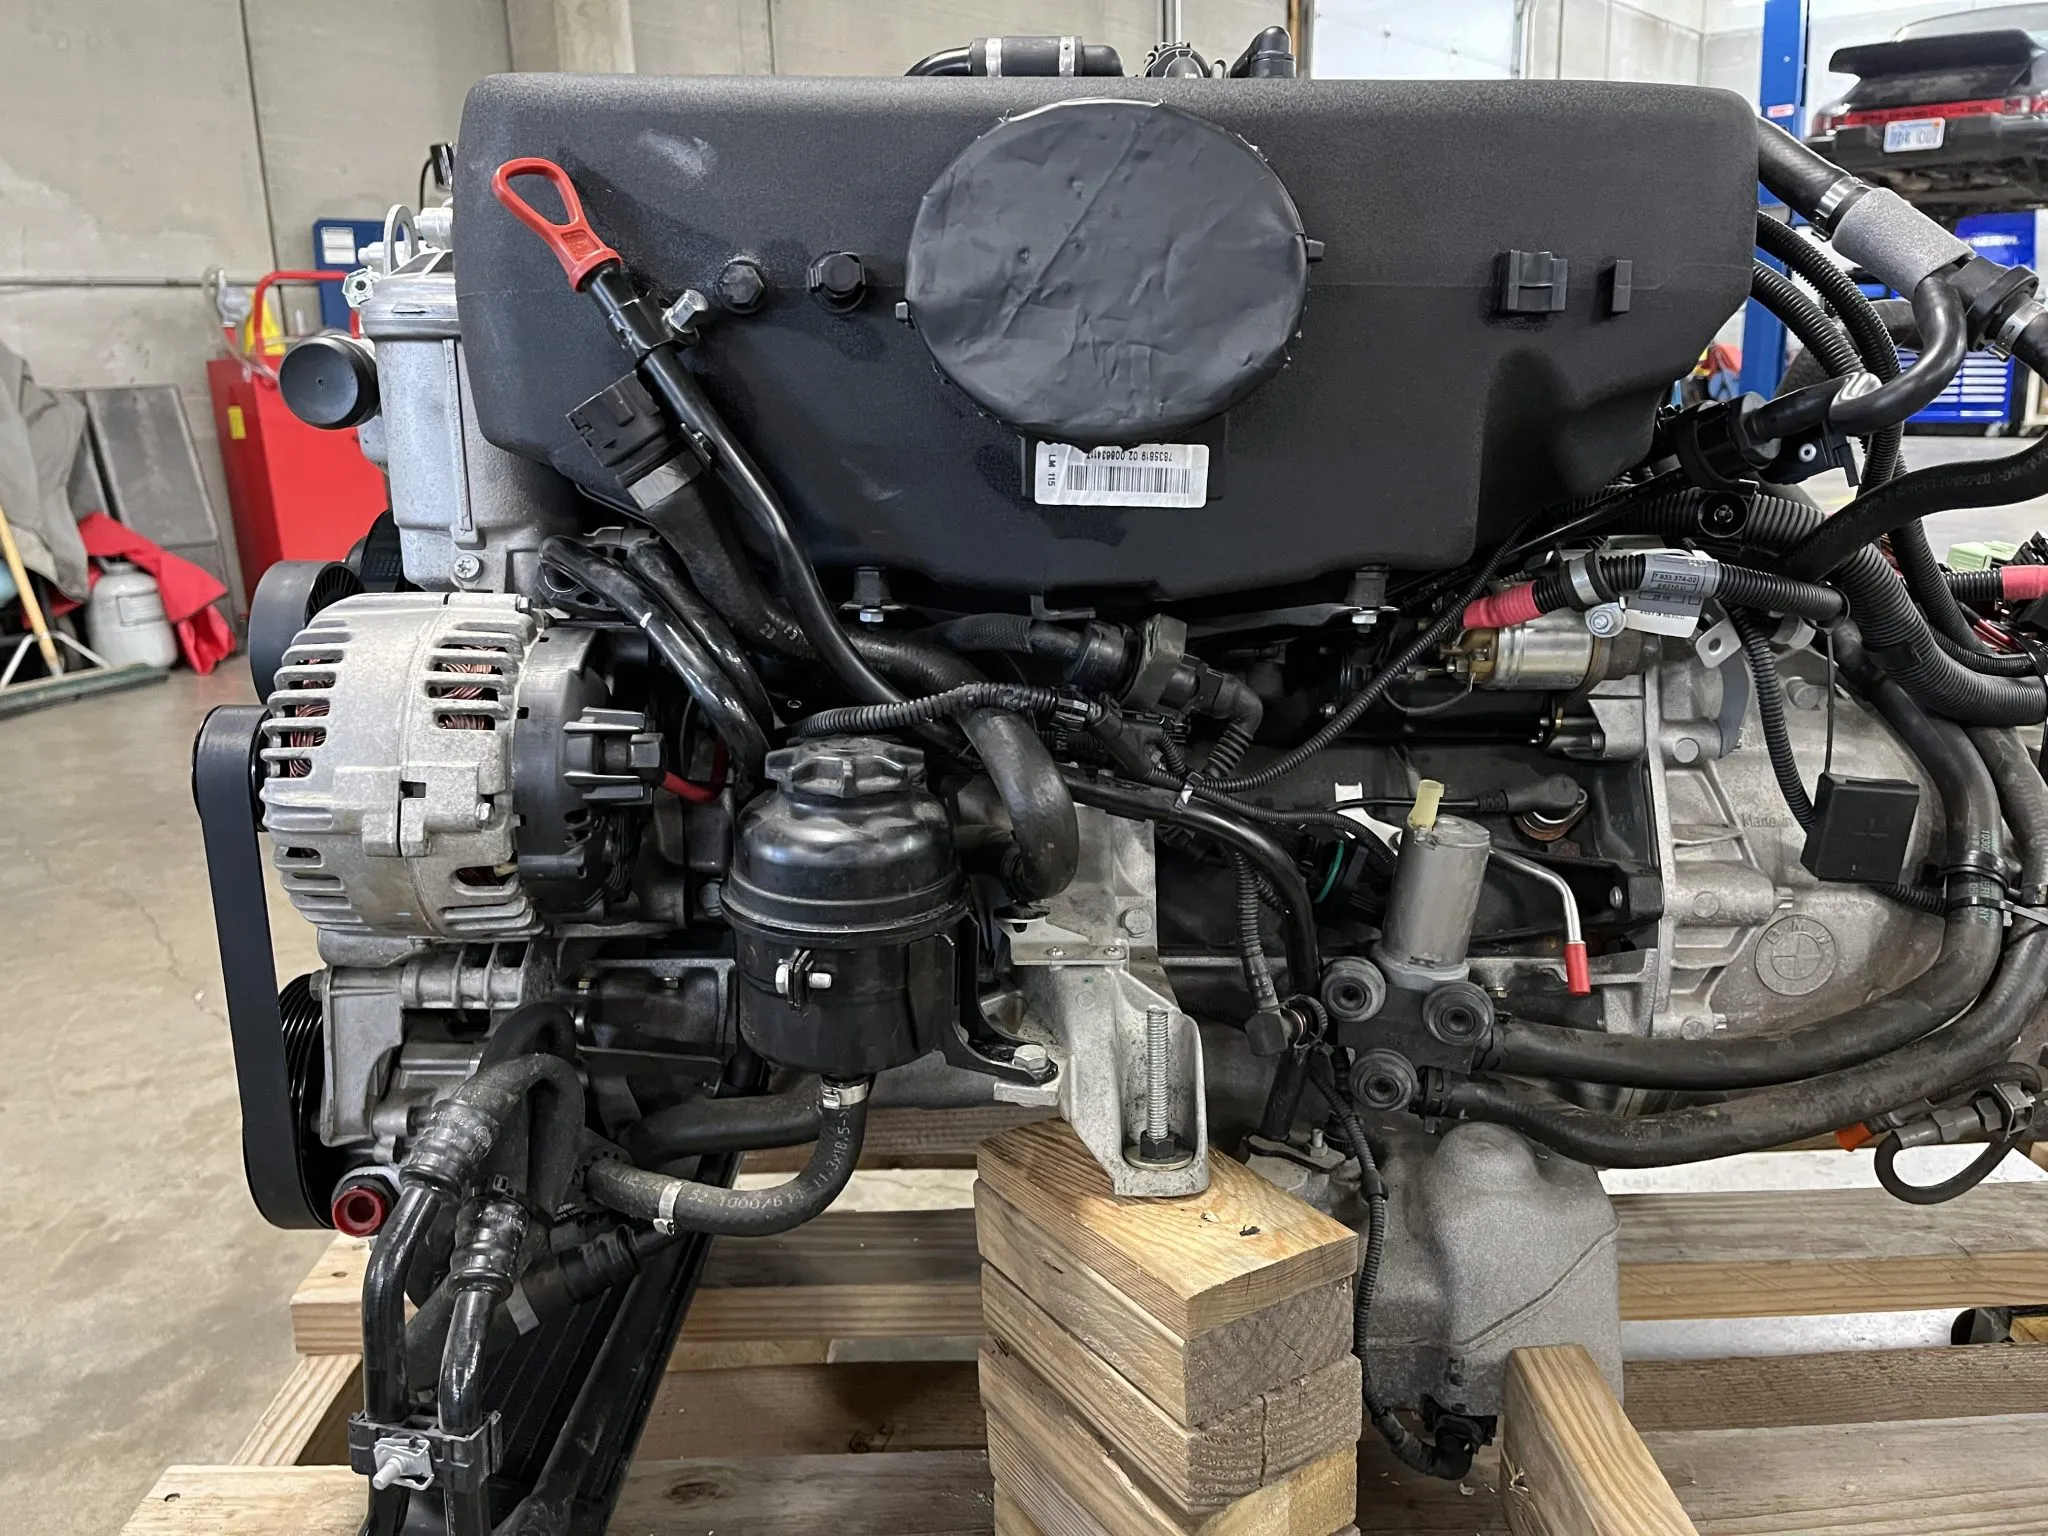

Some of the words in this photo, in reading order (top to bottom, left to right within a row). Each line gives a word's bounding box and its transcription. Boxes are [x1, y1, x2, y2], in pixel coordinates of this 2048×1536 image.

[1048, 454, 1057, 467] LM
[1128, 451, 1138, 461] 02
[1047, 472, 1056, 487] 115
[1741, 813, 1777, 828] Made
[1783, 813, 1794, 828] in
